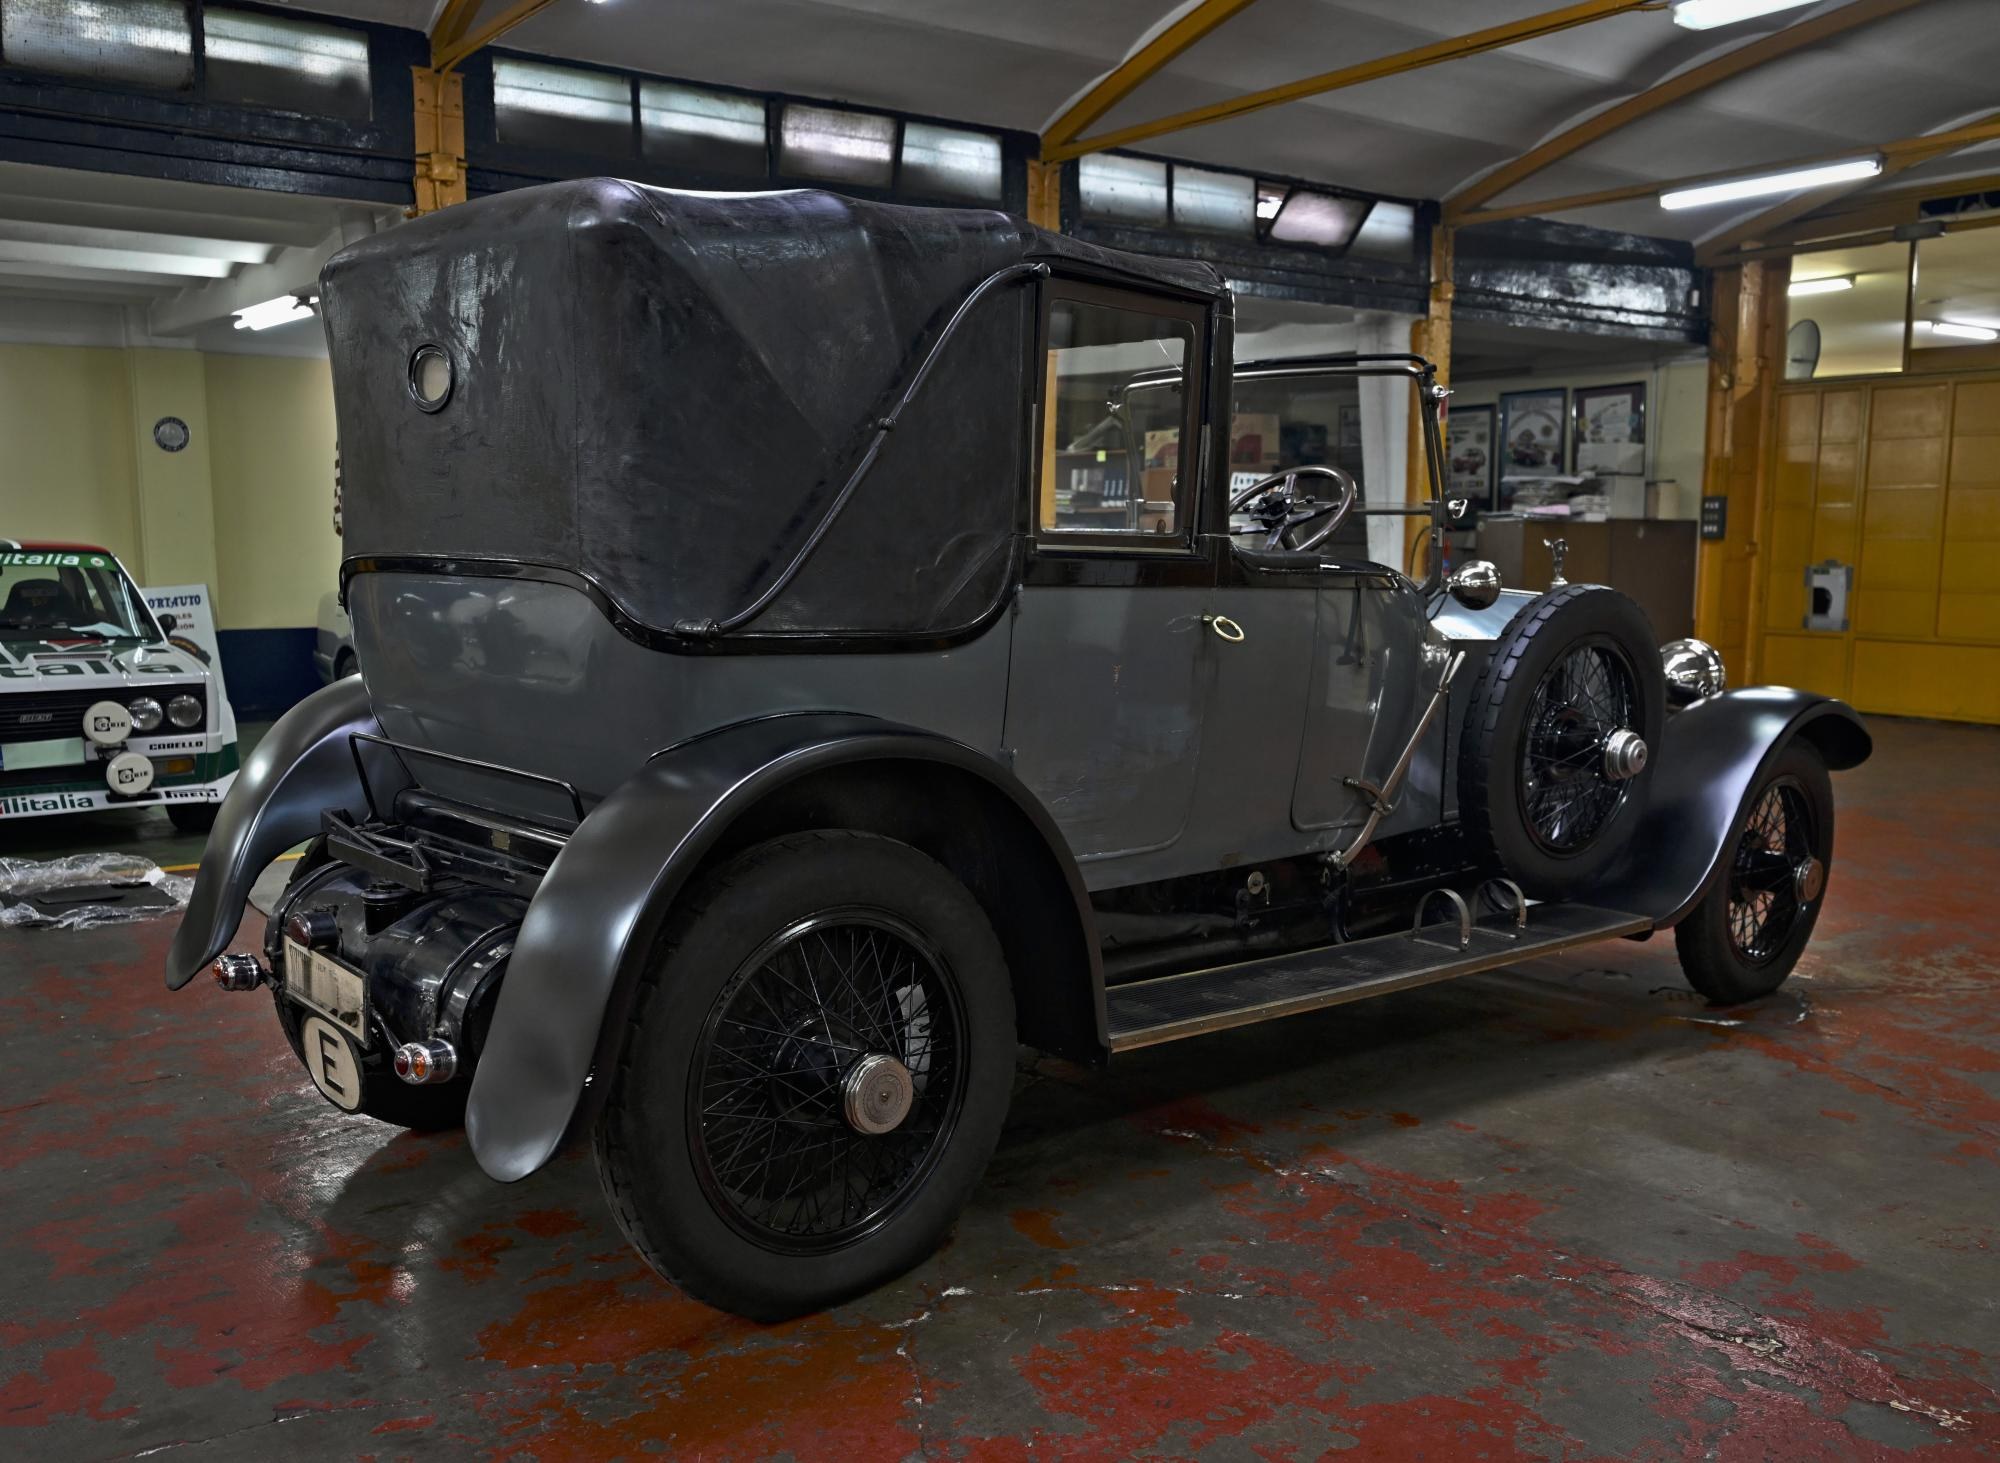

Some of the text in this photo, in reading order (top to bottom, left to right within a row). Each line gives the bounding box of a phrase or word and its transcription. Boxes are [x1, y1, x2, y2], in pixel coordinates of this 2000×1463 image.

[0, 553, 80, 566] italia
[148, 594, 201, 609] ORTAUTO
[318, 1029, 345, 1096] E
